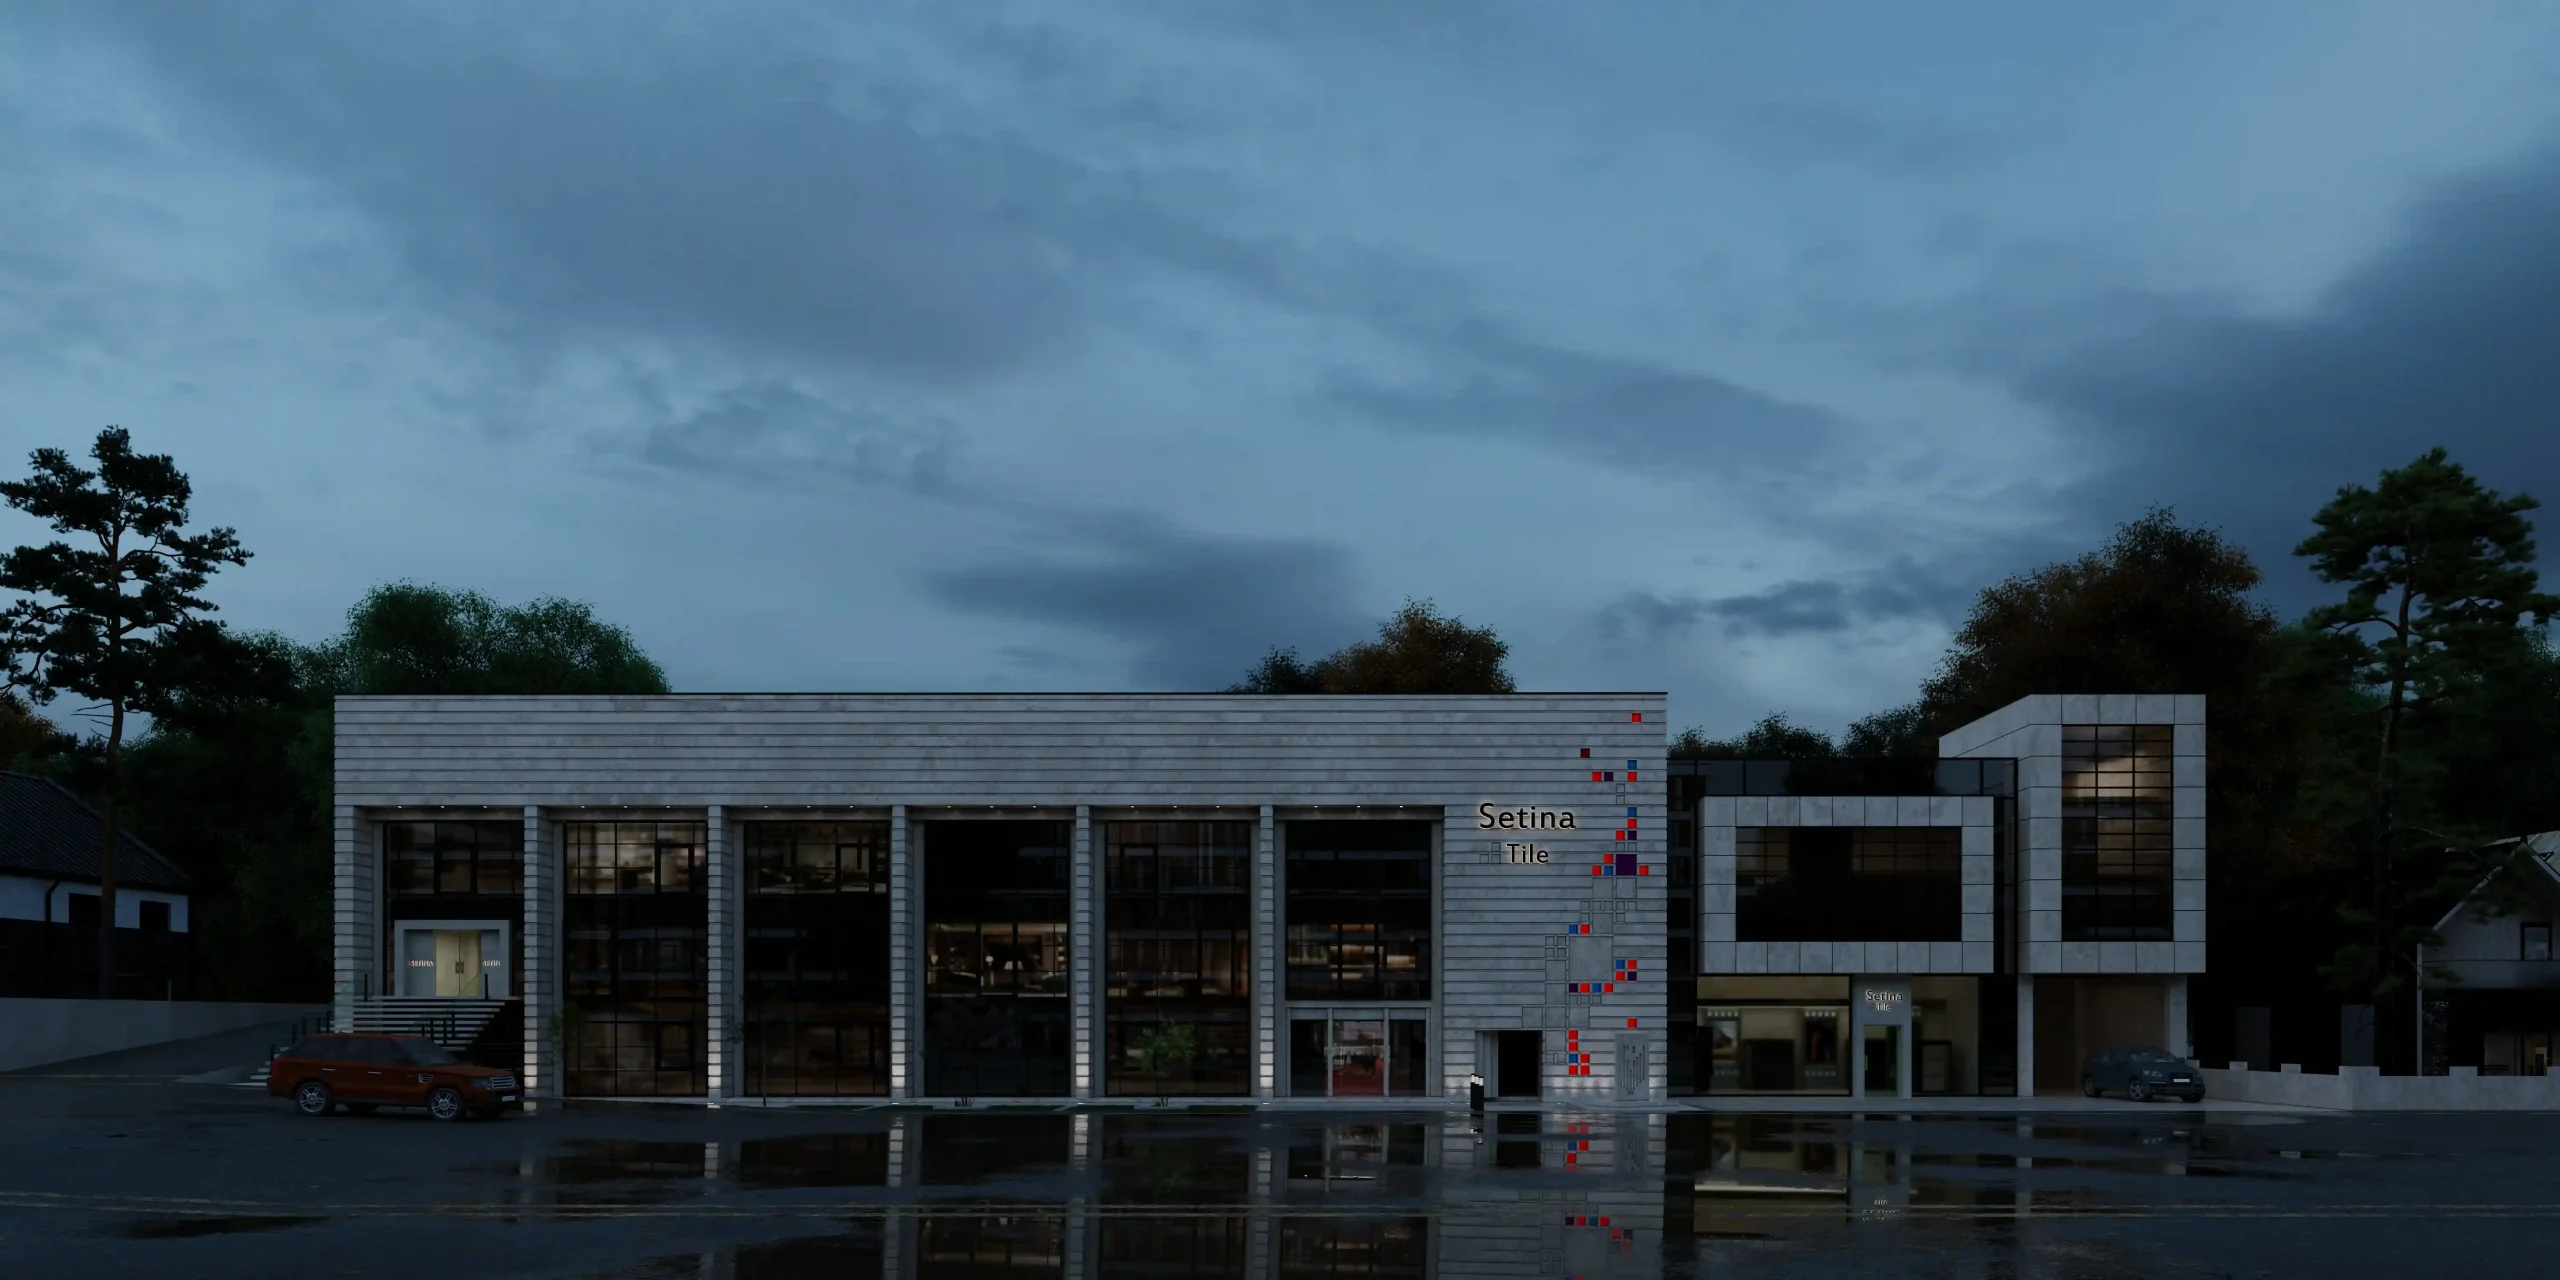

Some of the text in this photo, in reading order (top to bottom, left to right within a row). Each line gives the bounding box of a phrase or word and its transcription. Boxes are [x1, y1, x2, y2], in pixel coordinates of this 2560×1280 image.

[1479, 802, 1576, 829] Setina
[1506, 843, 1549, 863] Tile
[1866, 989, 1903, 1001] Setina
